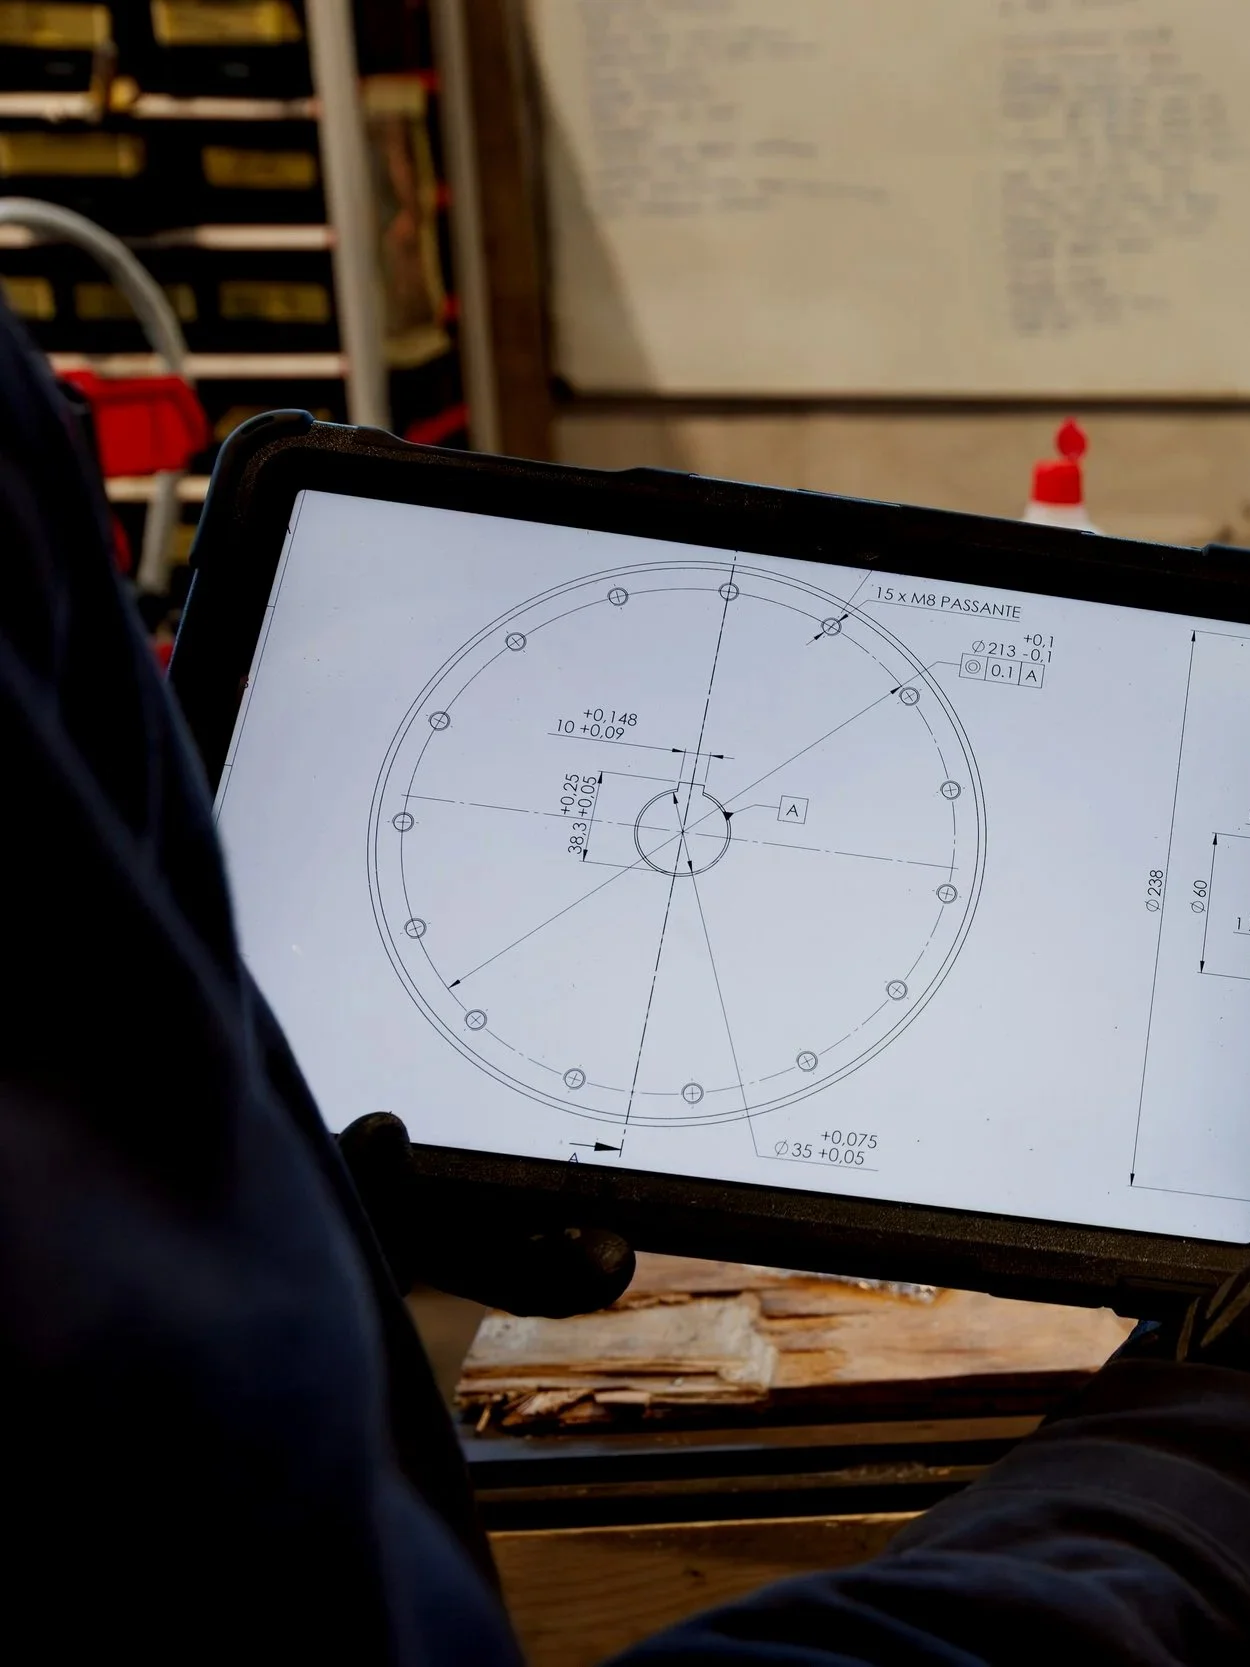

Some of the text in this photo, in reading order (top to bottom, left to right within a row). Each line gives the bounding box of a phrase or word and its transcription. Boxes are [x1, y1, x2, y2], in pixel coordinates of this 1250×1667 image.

[876, 586, 894, 600] 15
[911, 592, 936, 606] M8
[941, 596, 1022, 619] PASSANTE
[991, 665, 1038, 682] 0.1 A
[583, 708, 638, 727] +0,148
[557, 719, 625, 740] 10 +0,09
[786, 804, 799, 817] A
[1236, 917, 1241, 930] 1
[820, 1130, 878, 1150] +0,075
[817, 1147, 866, 1166] +0,05
